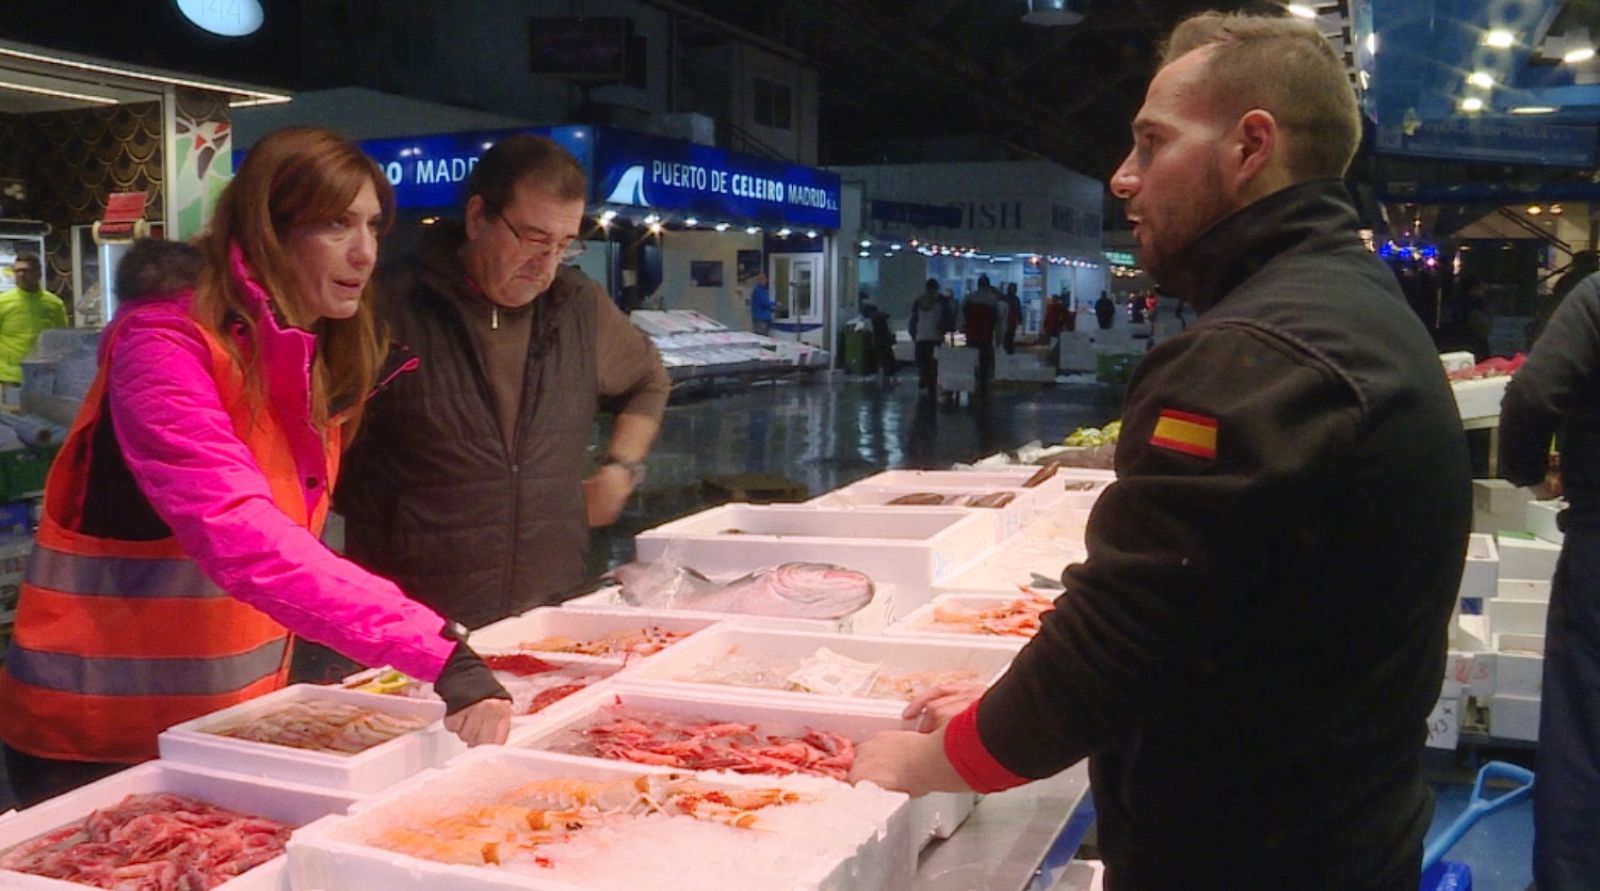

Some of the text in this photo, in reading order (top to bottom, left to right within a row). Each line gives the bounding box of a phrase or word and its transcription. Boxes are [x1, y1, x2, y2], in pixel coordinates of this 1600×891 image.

[652, 160, 707, 191] PUERTO
[711, 170, 728, 194] DE
[732, 174, 784, 203] CELEIRO
[788, 184, 827, 209] MADRID
